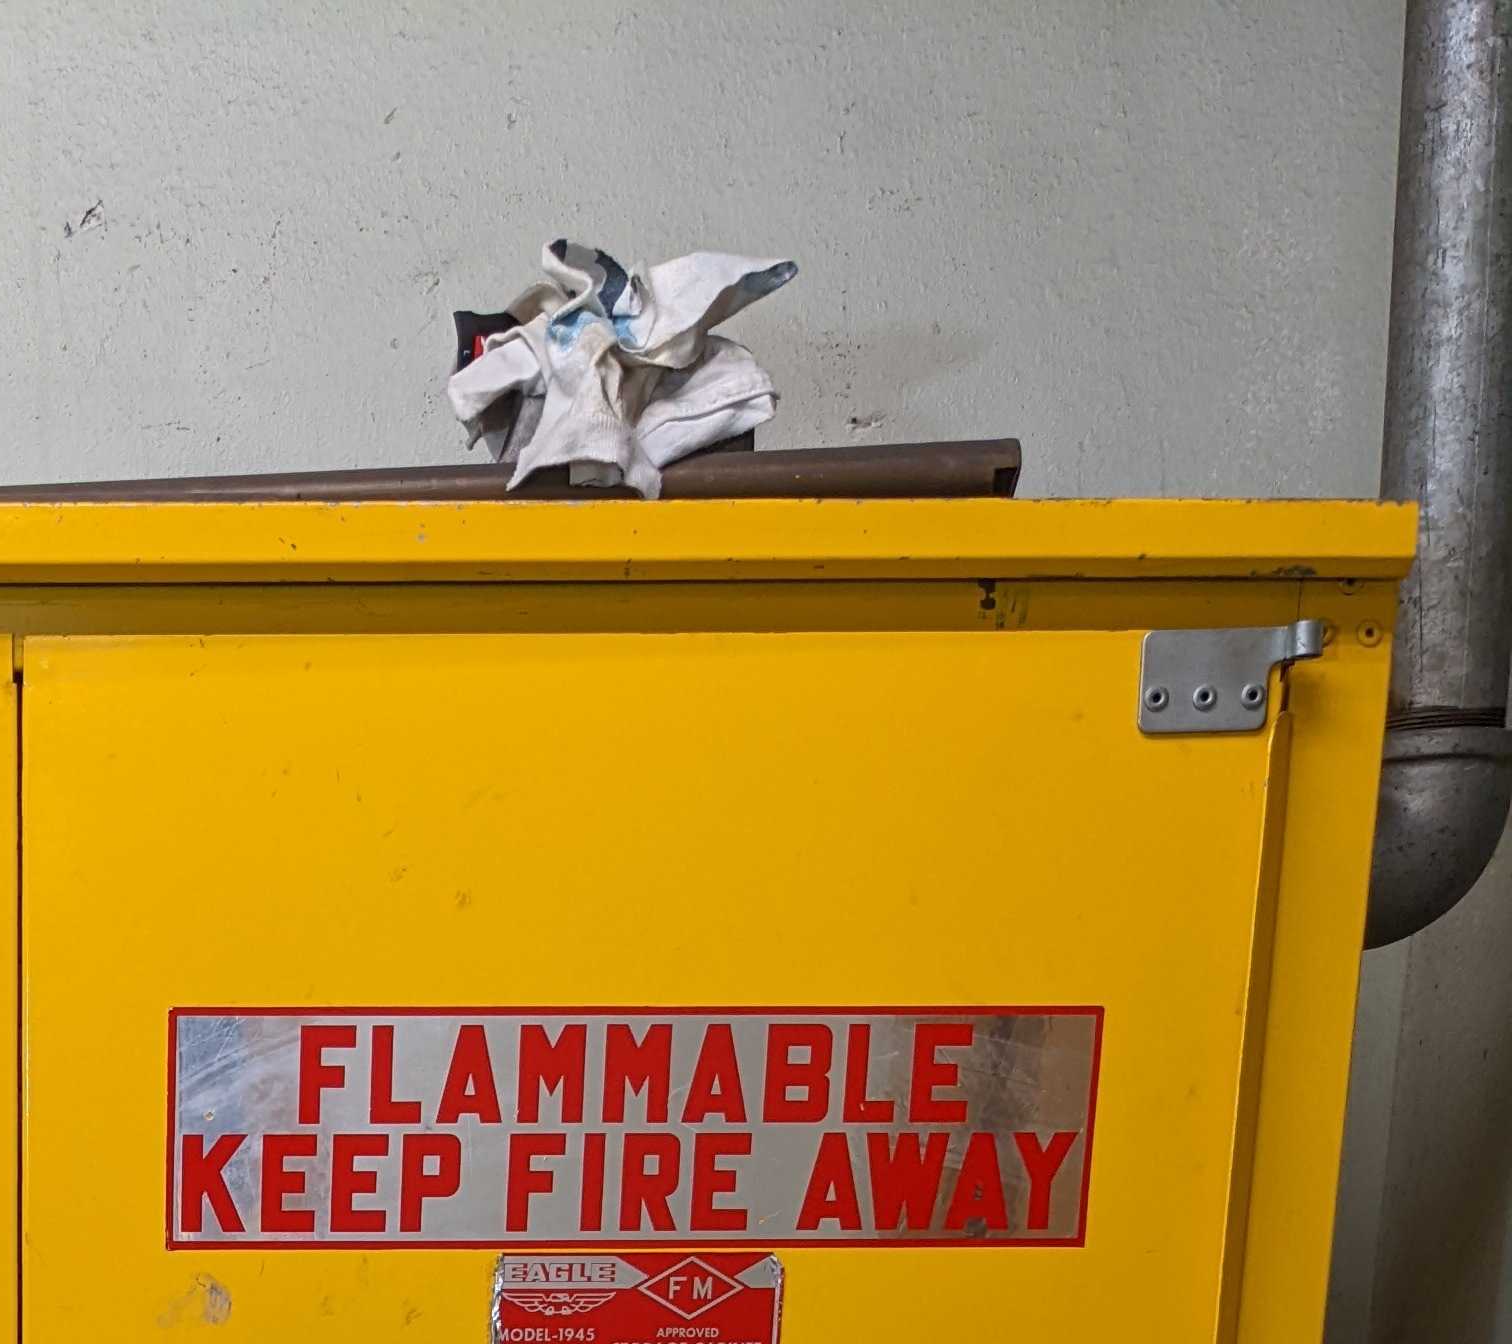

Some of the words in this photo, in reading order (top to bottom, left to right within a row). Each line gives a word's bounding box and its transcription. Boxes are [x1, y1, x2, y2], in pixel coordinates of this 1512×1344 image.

[298, 1022, 975, 1125] FLAMMABLE
[180, 1133, 463, 1233] KEEP
[506, 1132, 752, 1232] FIRE
[796, 1131, 1079, 1231] AWAY
[503, 1262, 616, 1282] EAGLE
[499, 1328, 596, 1341] MODEL-1945
[656, 1327, 719, 1338] APPROVED
